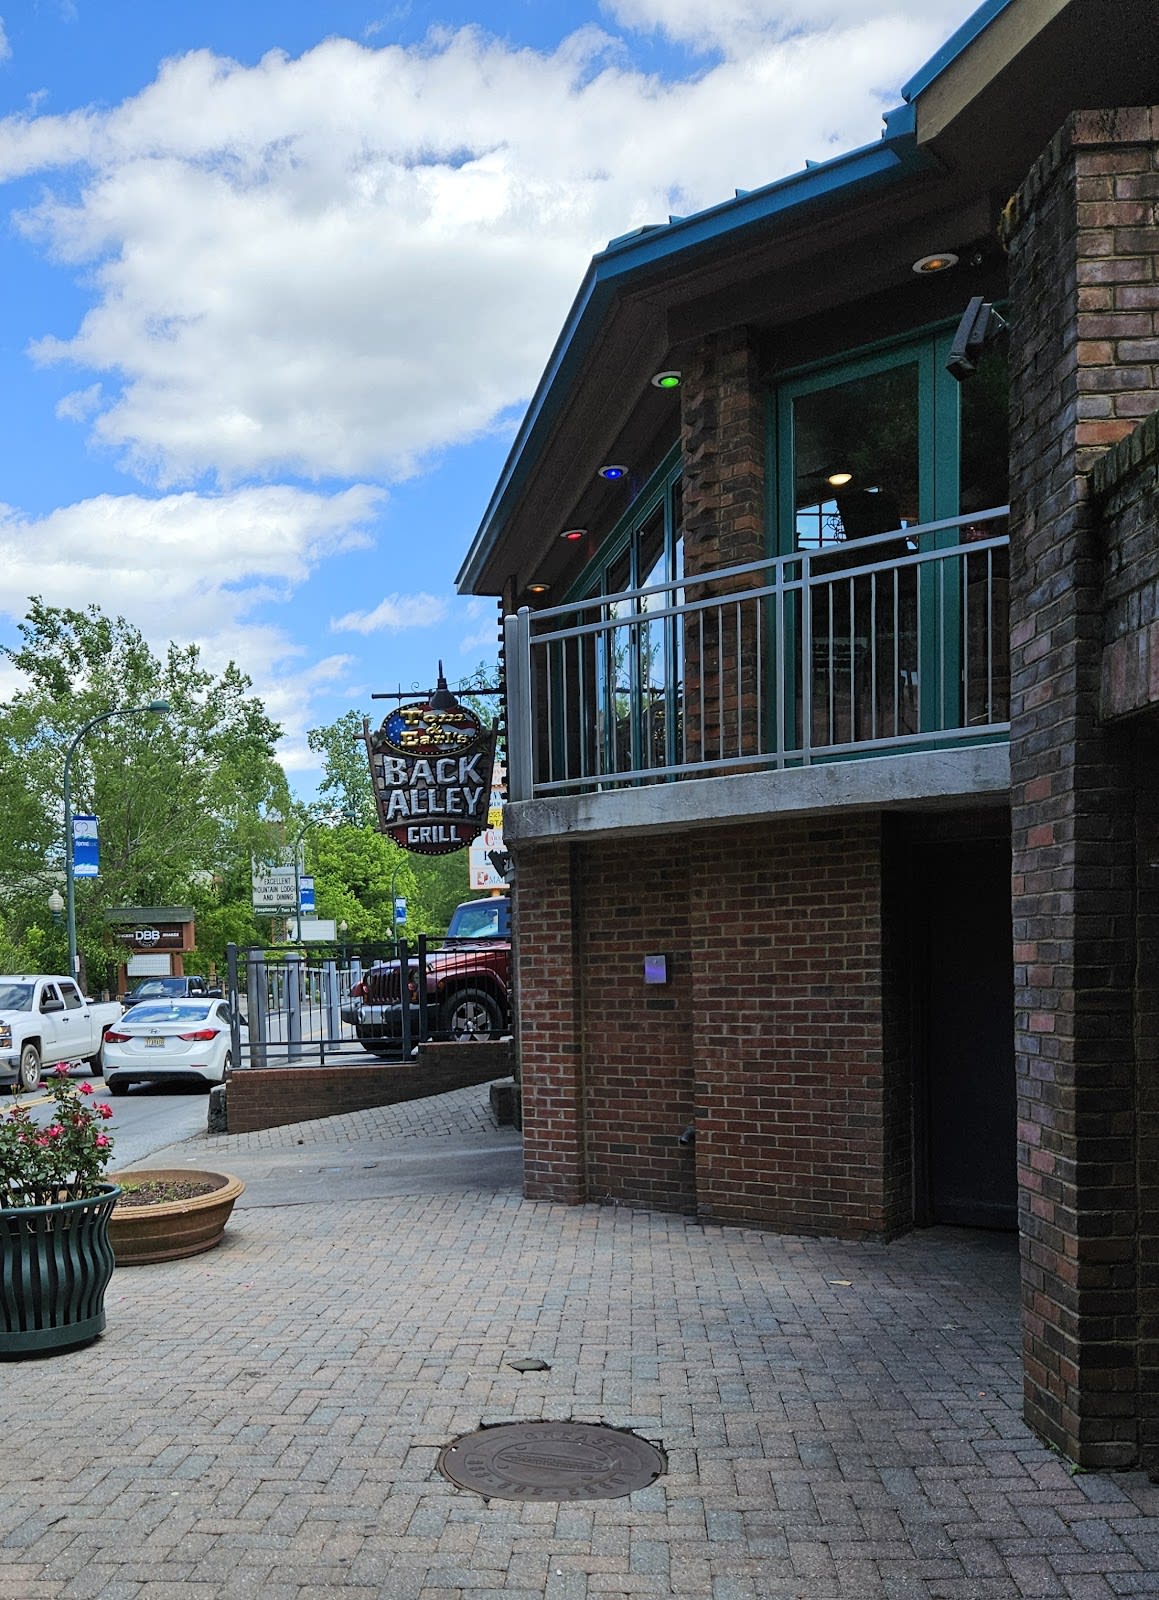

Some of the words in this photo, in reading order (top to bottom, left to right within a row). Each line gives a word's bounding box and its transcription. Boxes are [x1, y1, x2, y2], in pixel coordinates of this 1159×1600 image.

[400, 710, 466, 725] Tom
[425, 723, 443, 735] &
[400, 731, 469, 746] Earl's
[383, 753, 485, 786] BACK
[386, 787, 485, 820] ALLEY
[407, 825, 462, 844] GRILL
[264, 877, 291, 886] EXCELLENT
[263, 894, 273, 902] AND
[276, 893, 294, 901] DINING
[135, 930, 161, 941] DBB
[525, 1431, 621, 1450] GREASE
